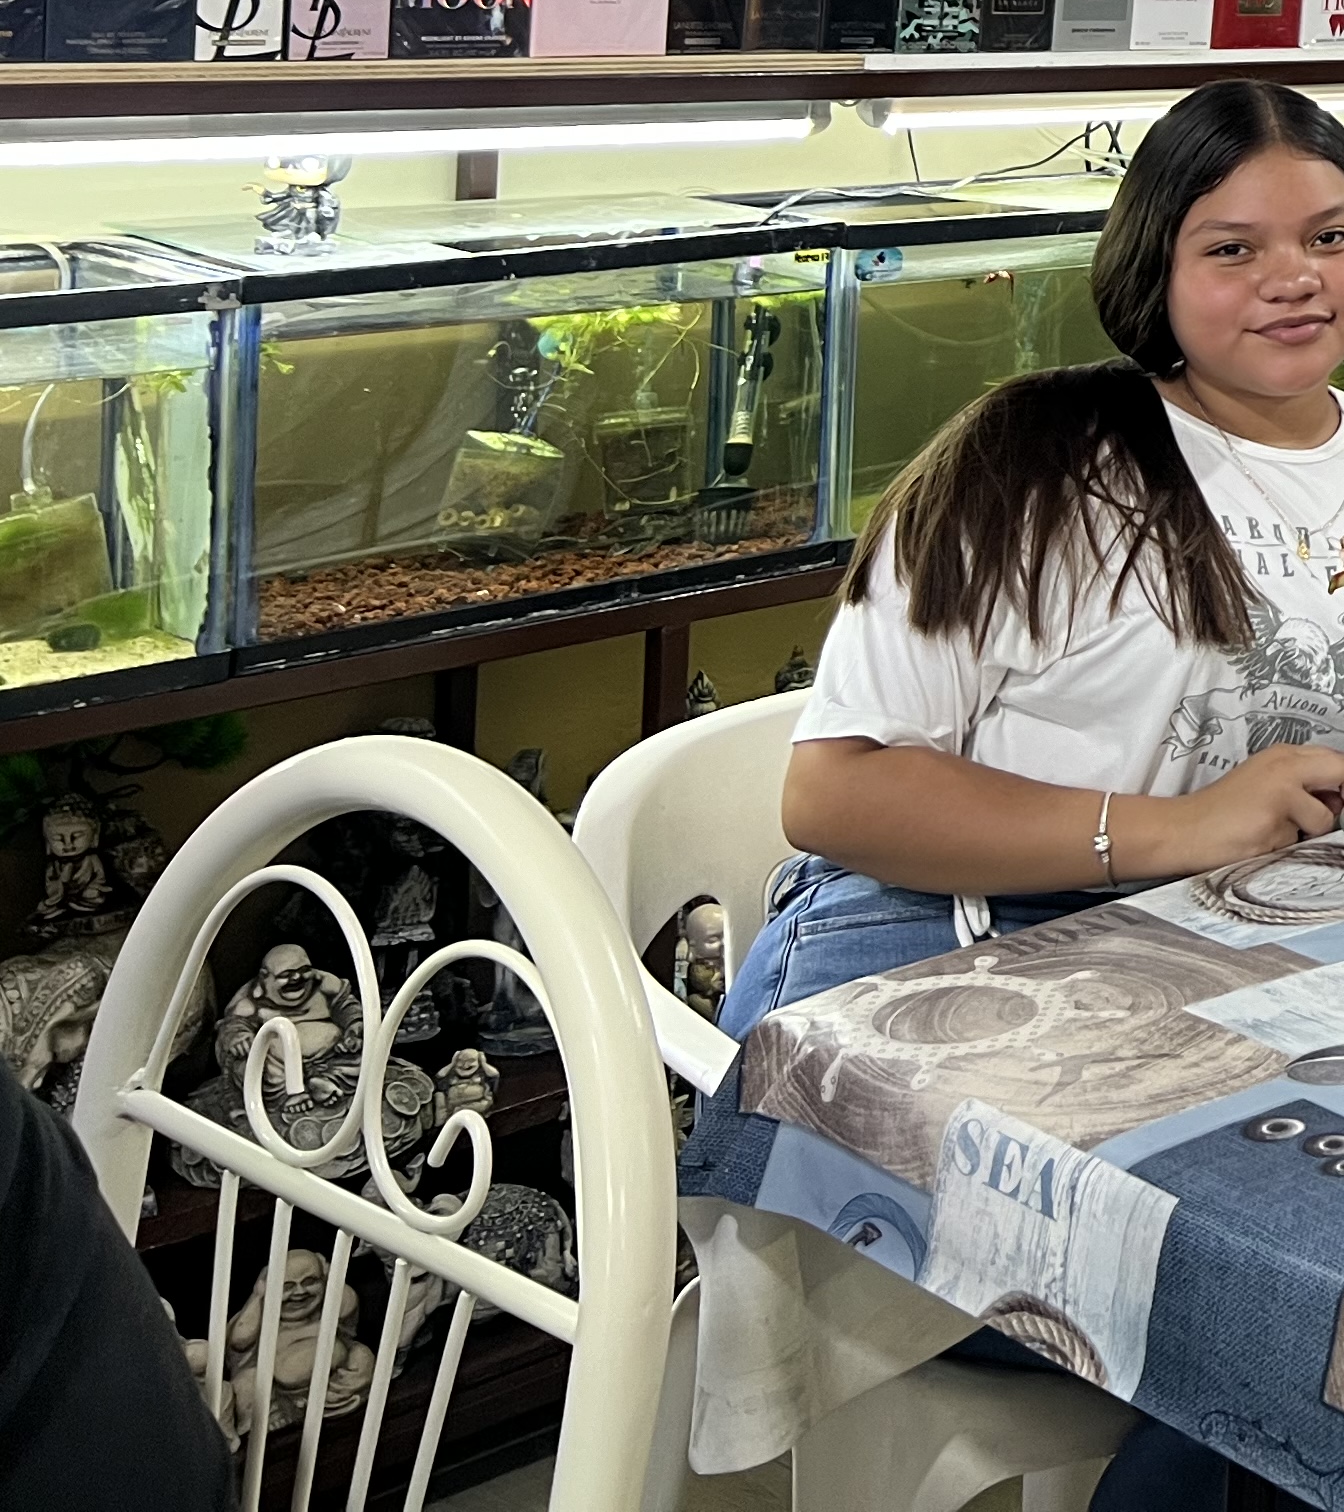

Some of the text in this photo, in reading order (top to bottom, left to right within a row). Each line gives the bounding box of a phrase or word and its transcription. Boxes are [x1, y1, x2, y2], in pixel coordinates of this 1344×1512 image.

[1261, 690, 1329, 717] Arizona
[1000, 902, 1149, 958] BOAT
[951, 1116, 1062, 1222] SEA
